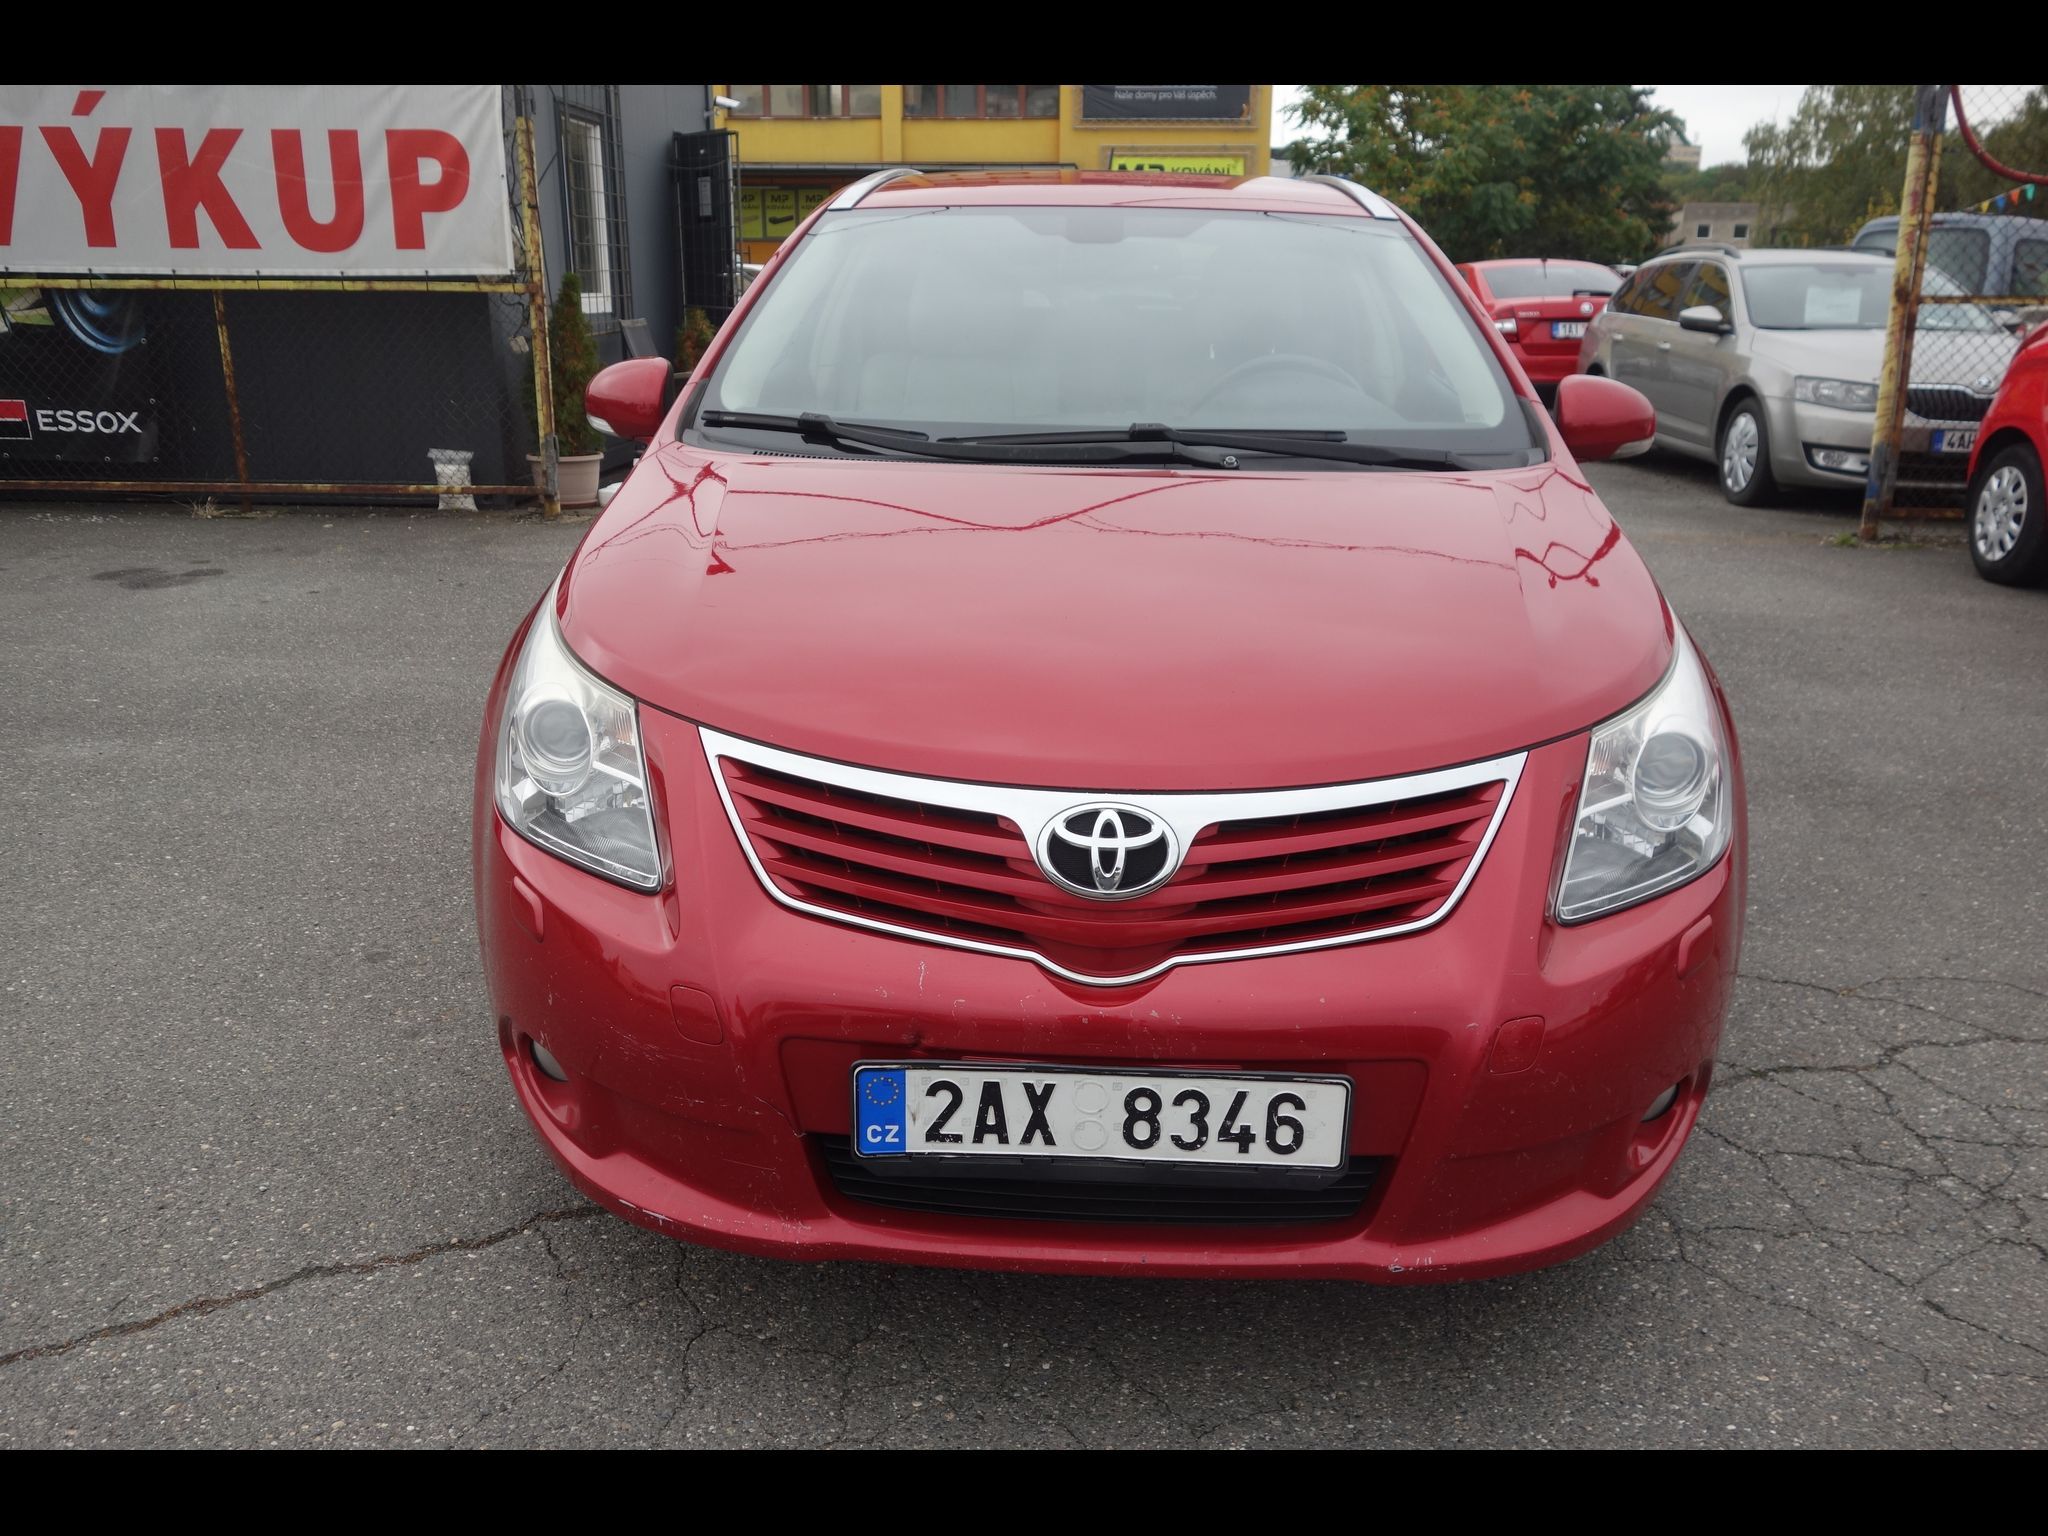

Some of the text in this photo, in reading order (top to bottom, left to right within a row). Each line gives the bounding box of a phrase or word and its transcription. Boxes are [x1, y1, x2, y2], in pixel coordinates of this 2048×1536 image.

[36, 409, 143, 434] ESSOX
[924, 1079, 1307, 1155] 2AX 8346
[866, 1124, 900, 1144] CZ
